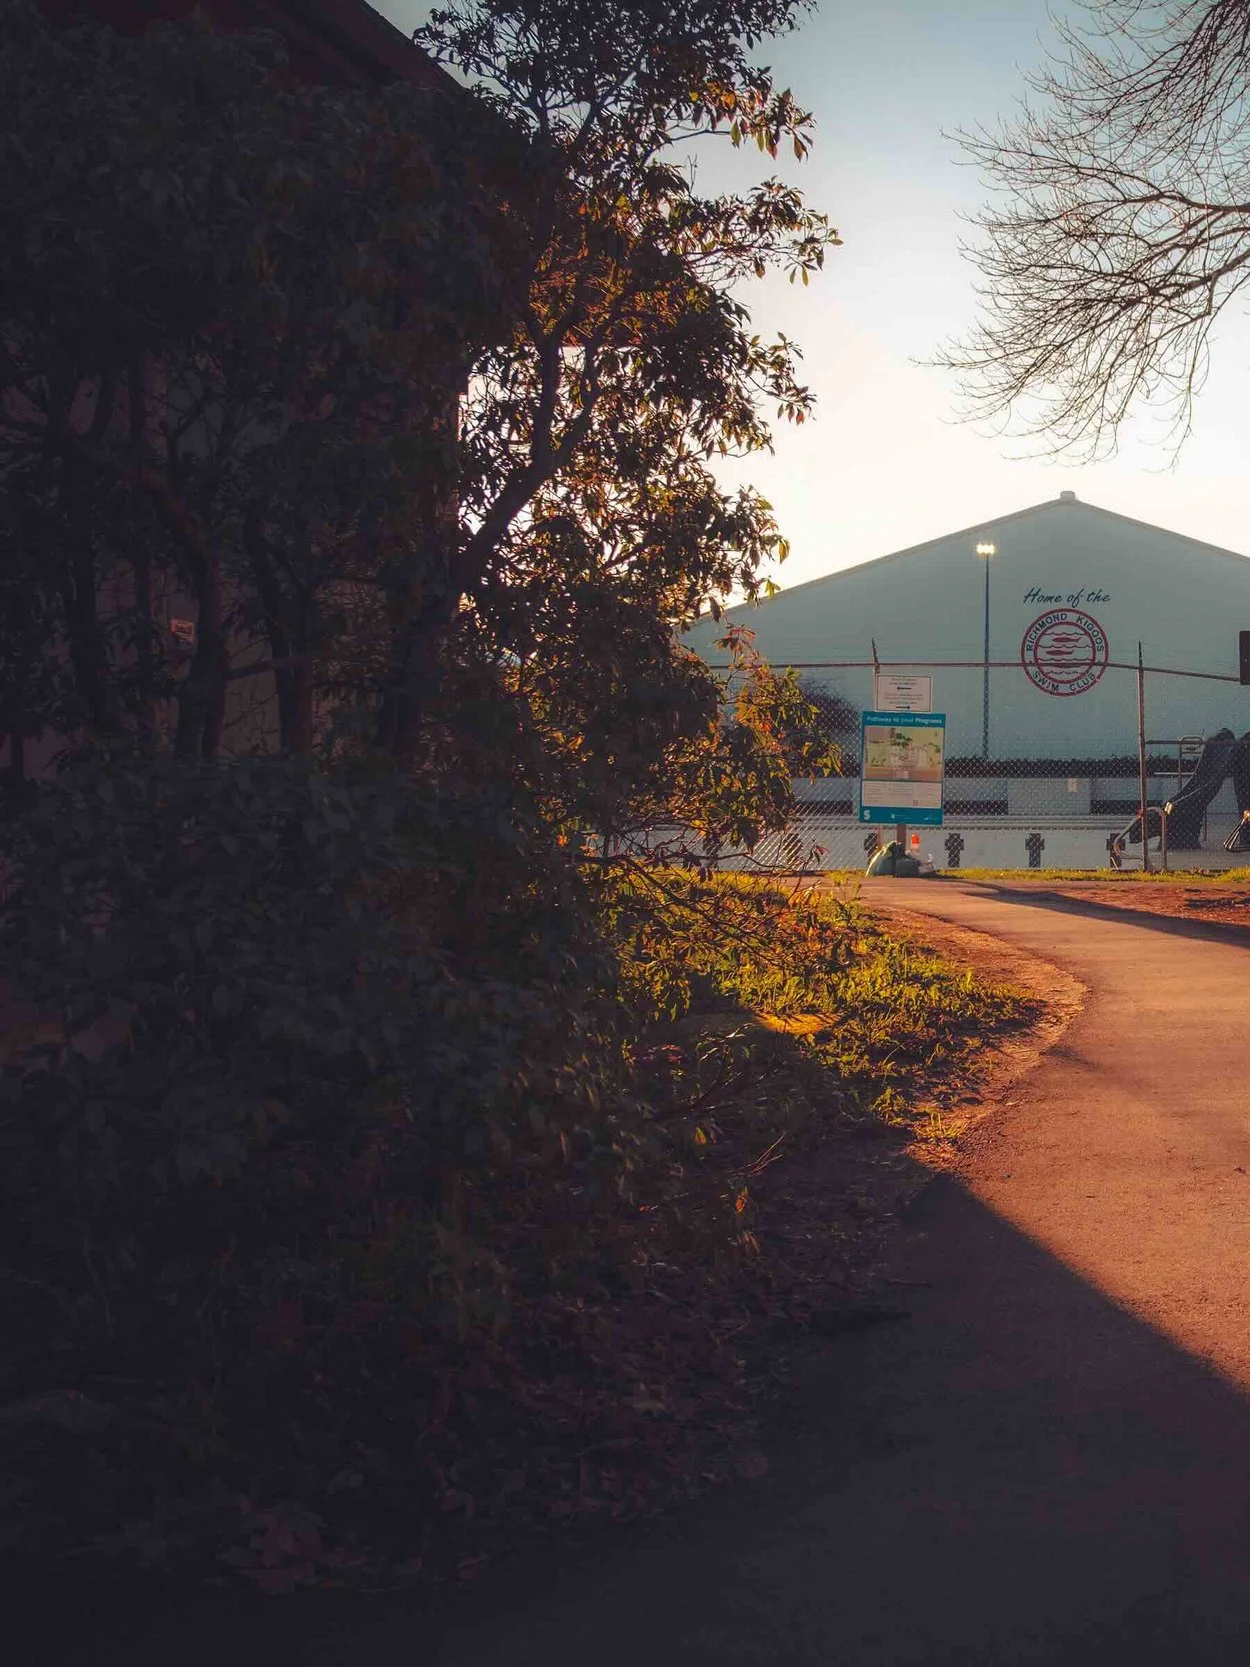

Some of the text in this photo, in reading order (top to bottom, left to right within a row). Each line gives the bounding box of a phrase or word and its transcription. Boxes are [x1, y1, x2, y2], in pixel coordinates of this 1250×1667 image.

[1023, 588, 1111, 608] Home of the
[1026, 613, 1105, 652] RICHMOND KIGOOS
[1032, 670, 1096, 691] SWIM CLUB
